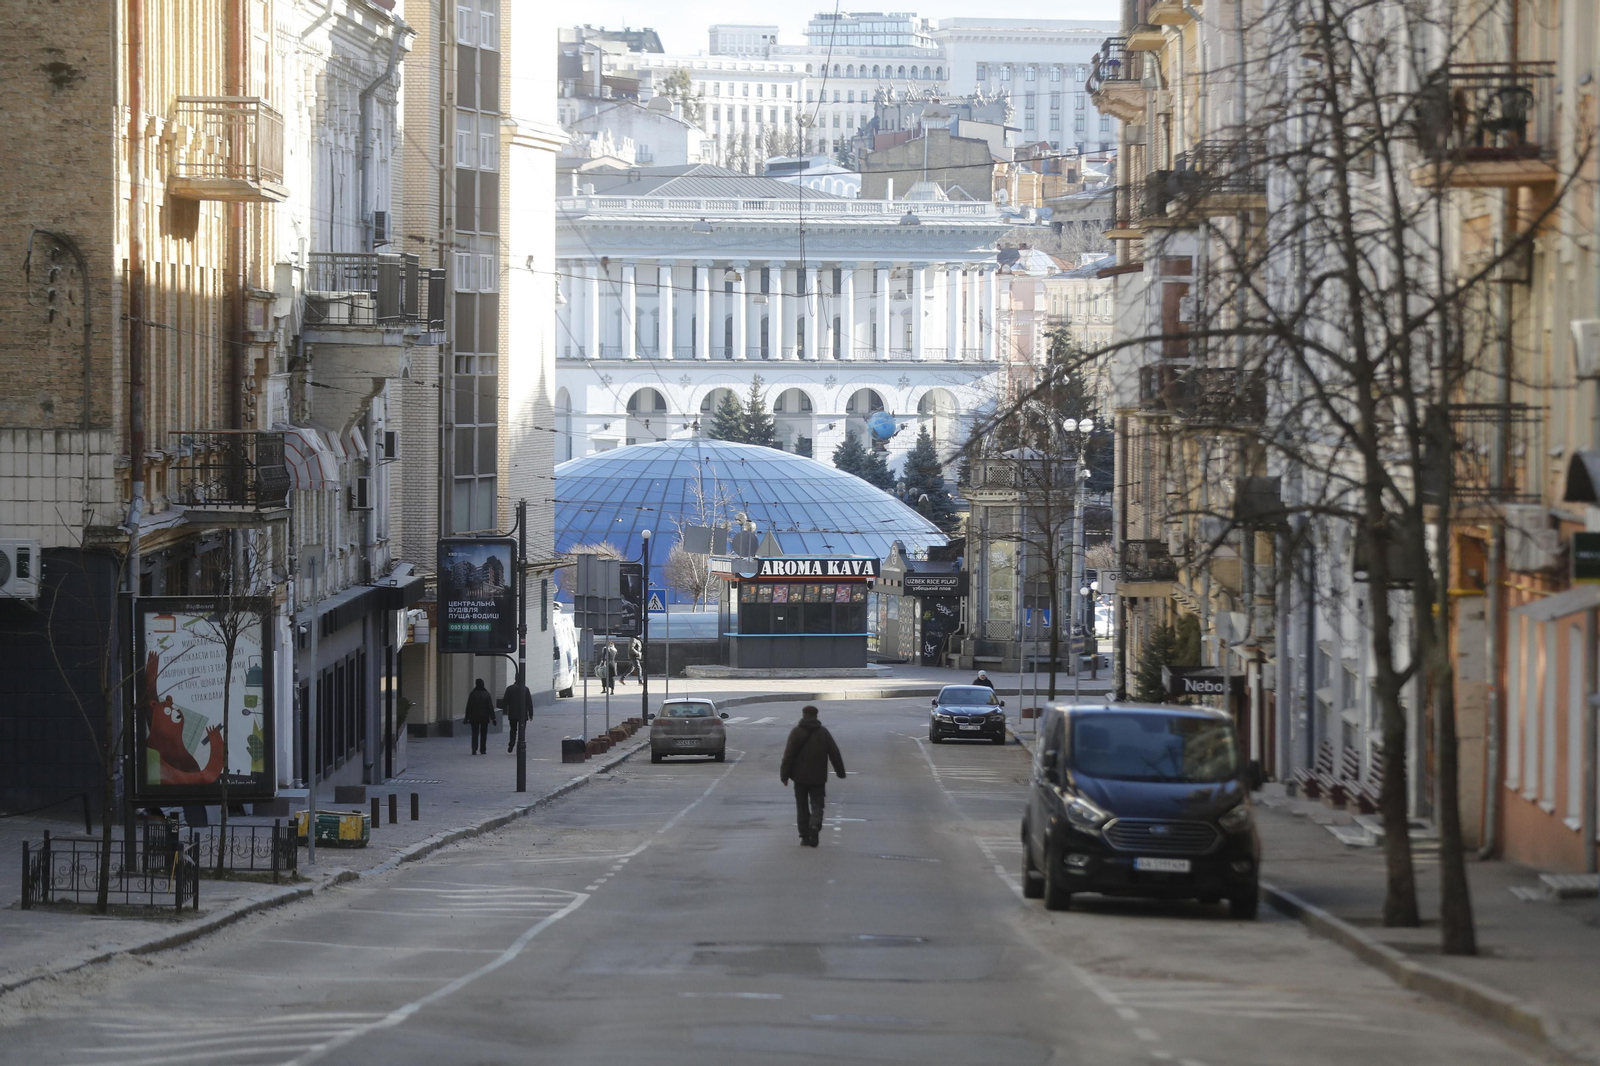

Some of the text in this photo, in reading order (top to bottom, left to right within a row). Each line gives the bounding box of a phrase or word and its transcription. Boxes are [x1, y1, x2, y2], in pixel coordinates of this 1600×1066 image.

[760, 560, 875, 575] AROMA KAVA
[182, 651, 208, 662] ПОКЛАСТИ
[161, 667, 186, 679] ЗАБОРОНУ
[191, 691, 224, 703] СТРАЖДАЛИ
